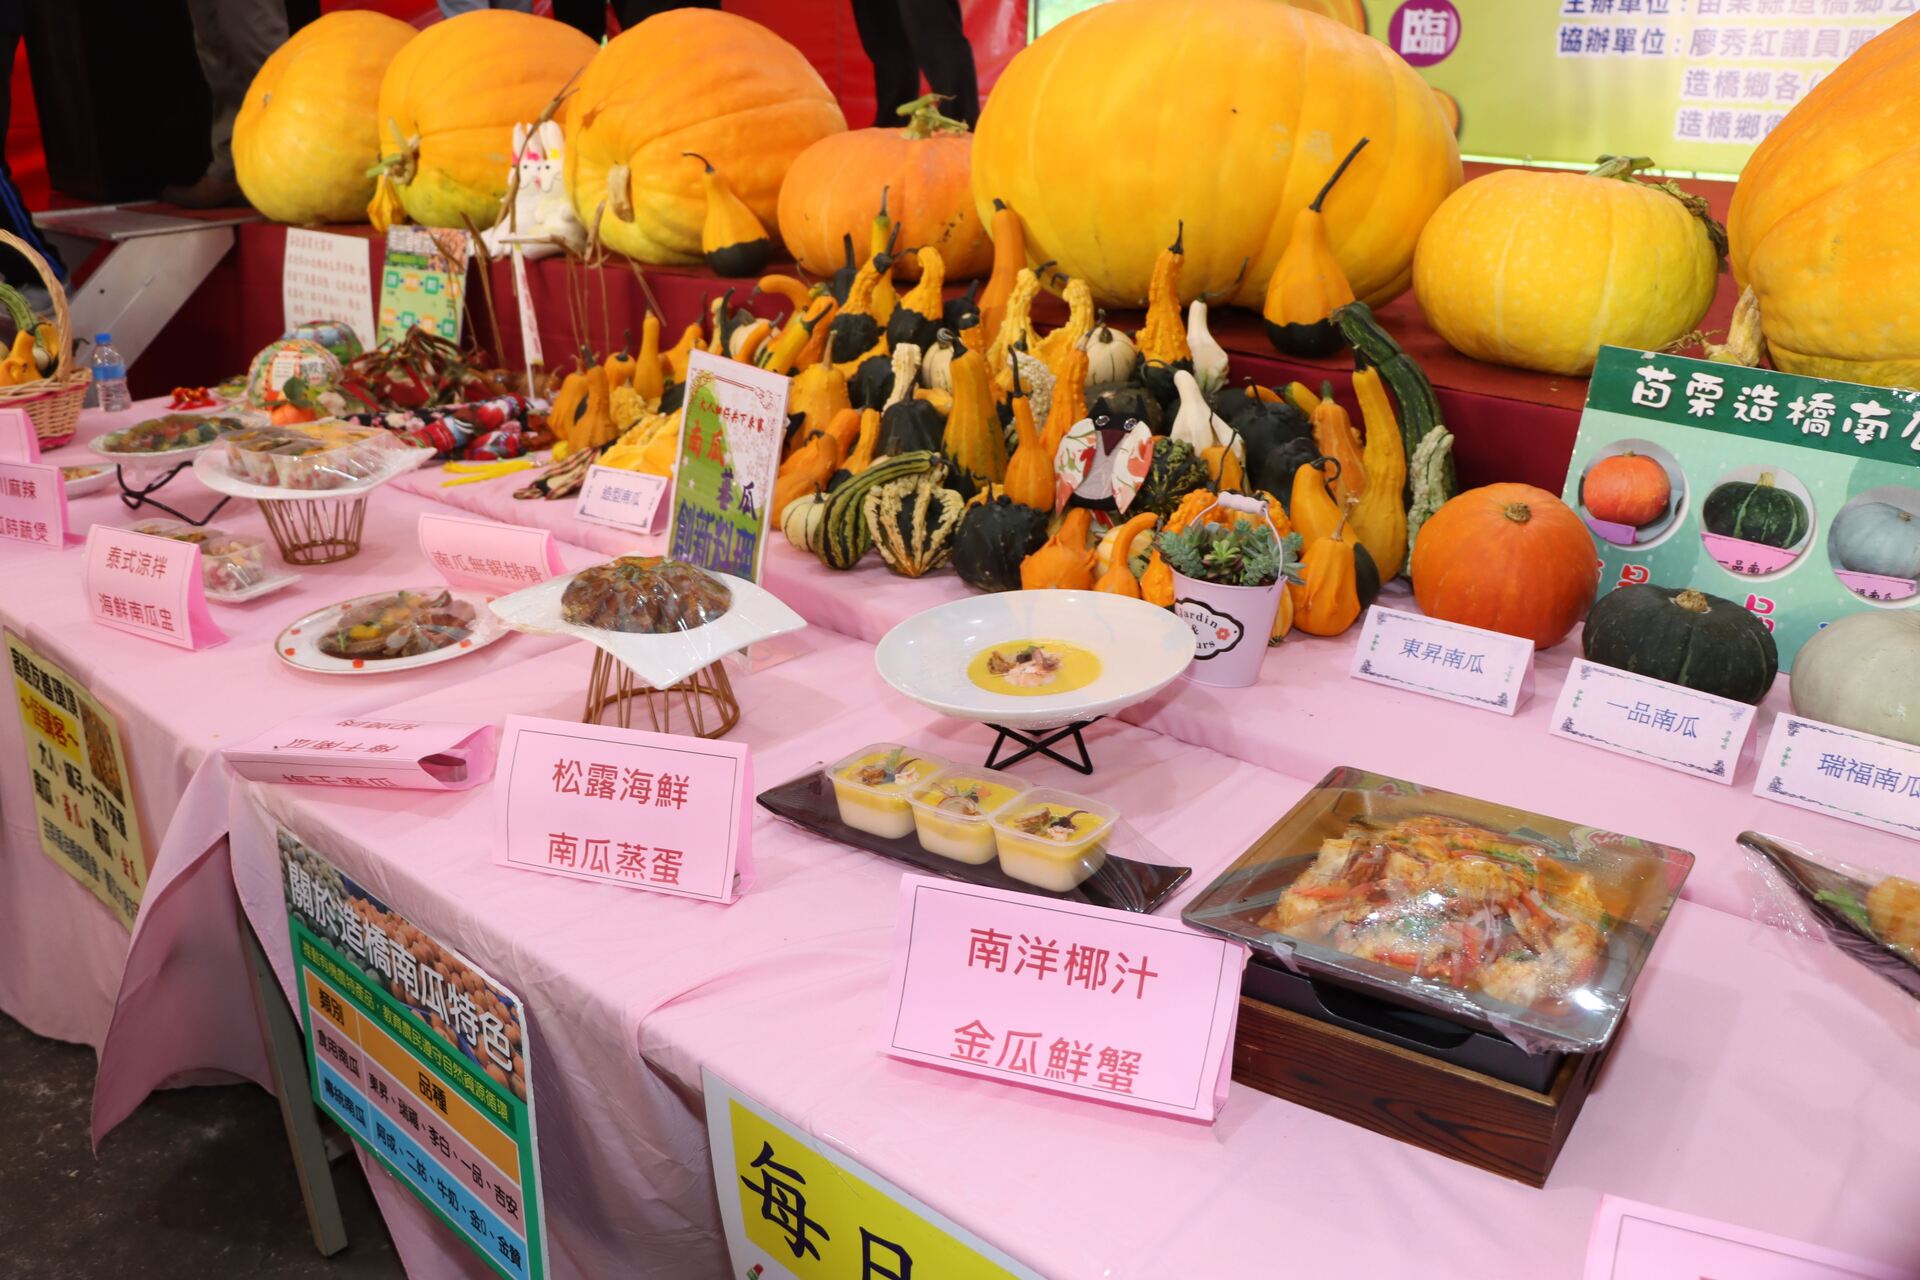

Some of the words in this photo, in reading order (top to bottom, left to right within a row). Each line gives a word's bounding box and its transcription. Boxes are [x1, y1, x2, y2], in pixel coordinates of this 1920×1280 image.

[106, 546, 168, 579] 泰式涼拌
[1399, 638, 1486, 674] 東昇南瓜
[1606, 701, 1701, 739] 一品南瓜
[552, 758, 690, 810] 松露海鮮
[1817, 752, 1920, 800] 瑞福南瓜
[548, 832, 684, 886] 南瓜蒸蛋
[288, 860, 513, 1073] 關於造橋南瓜特色
[966, 927, 1159, 1000] 南洋椰汁
[950, 1019, 1143, 1095] 金瓜鮮蟹
[418, 1071, 448, 1115] 品種
